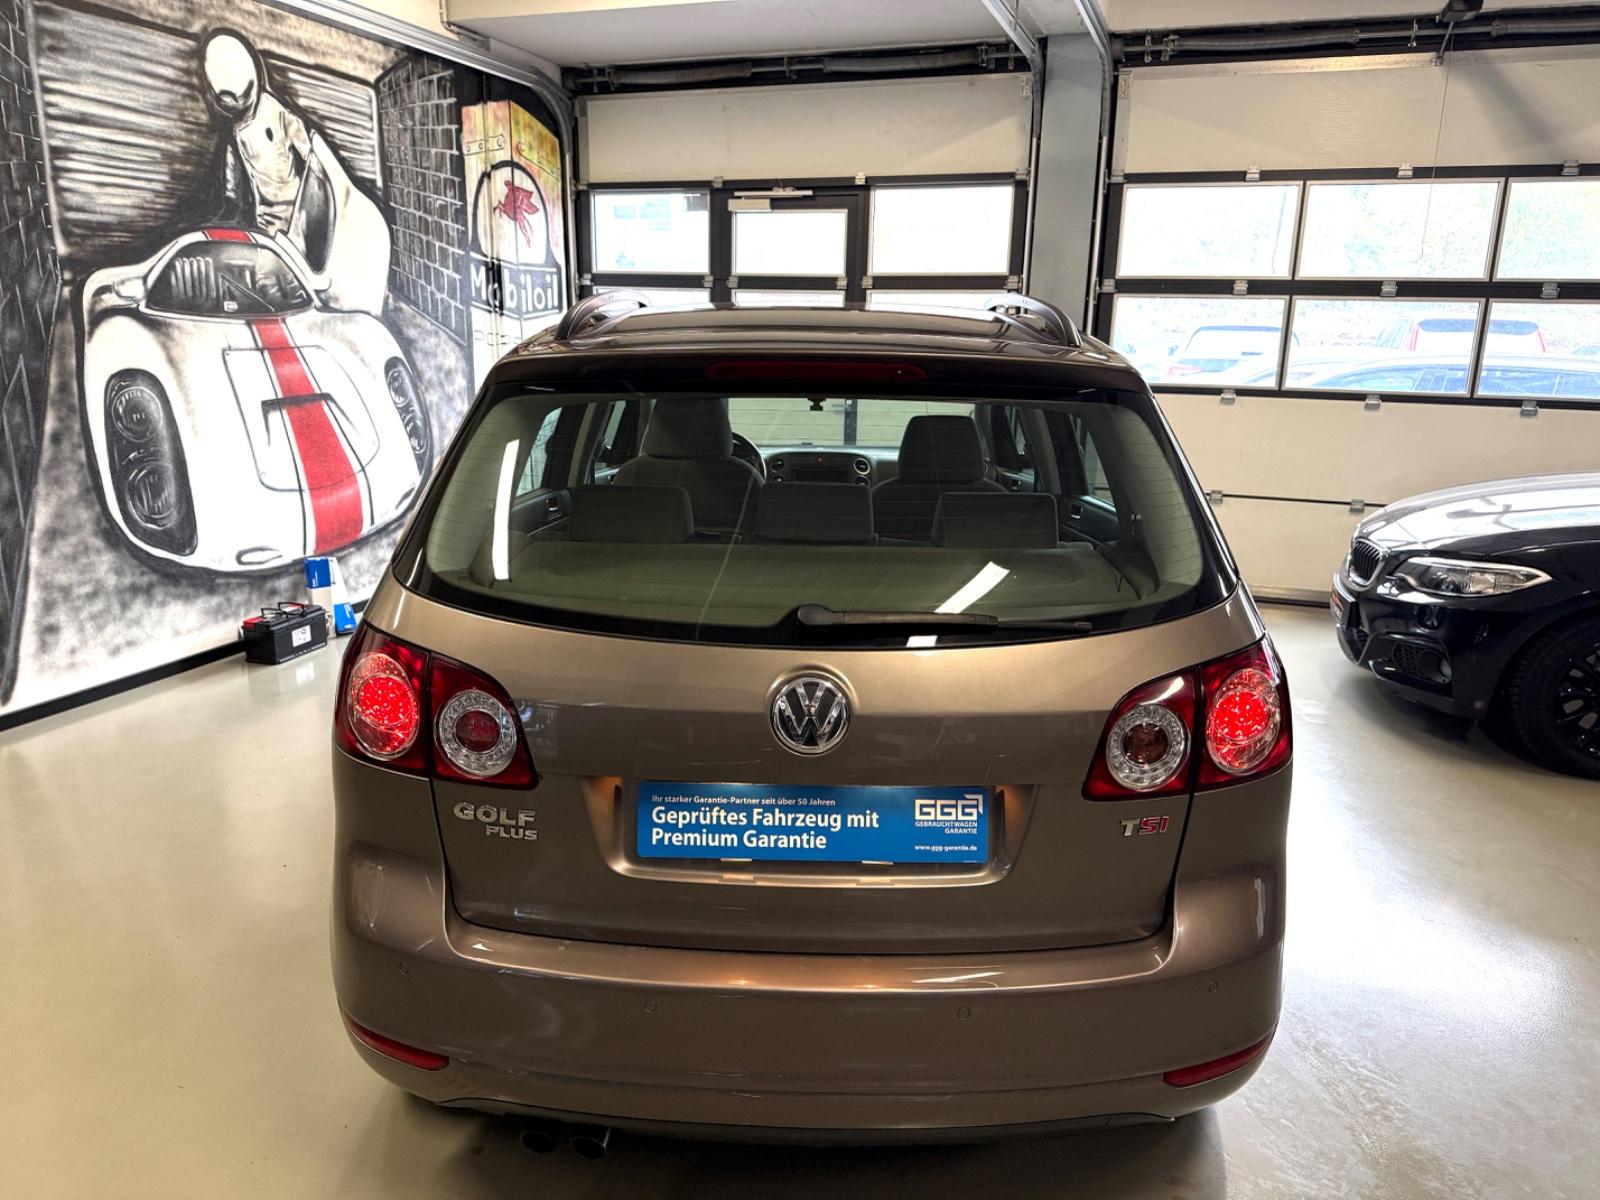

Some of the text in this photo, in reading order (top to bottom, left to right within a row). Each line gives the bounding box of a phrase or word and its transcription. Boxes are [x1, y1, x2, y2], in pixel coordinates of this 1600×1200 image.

[470, 263, 558, 313] Mobiloil
[651, 794, 836, 807] Ihr starker Garantie-Partner seit über 50 Jahren
[914, 799, 978, 820] GGG
[453, 801, 537, 827] GOLF
[651, 805, 880, 832] Geprüftes Fahrzeug mit
[914, 820, 978, 828] GEBRAUCHTWAGEN
[485, 824, 539, 841] PLUS
[1120, 815, 1170, 837] TSI
[651, 827, 828, 849] Premium Garantie
[913, 844, 978, 852] www.ggg-garantie.de
